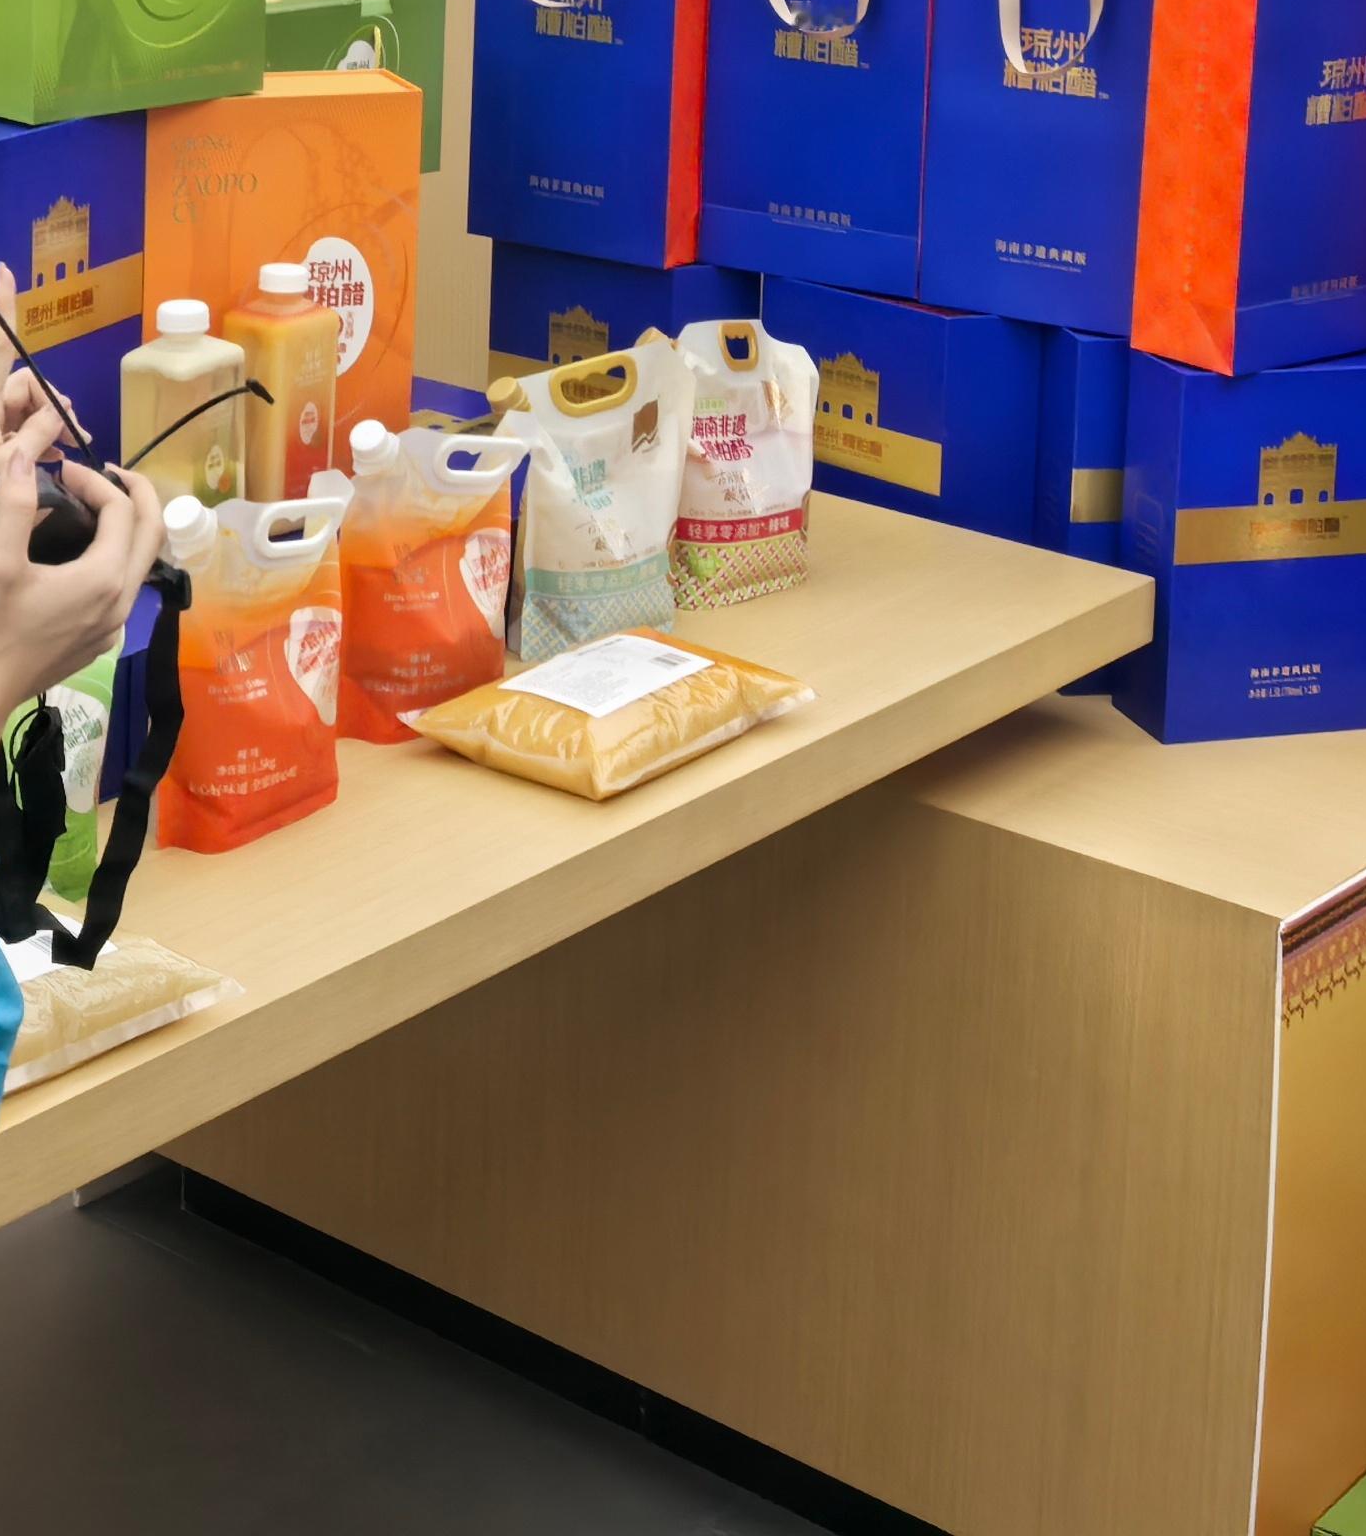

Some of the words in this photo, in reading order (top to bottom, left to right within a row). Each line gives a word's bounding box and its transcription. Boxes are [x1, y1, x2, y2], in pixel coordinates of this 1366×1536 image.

[1002, 58, 1097, 99] 糟粕醋
[306, 258, 353, 283] 琼州
